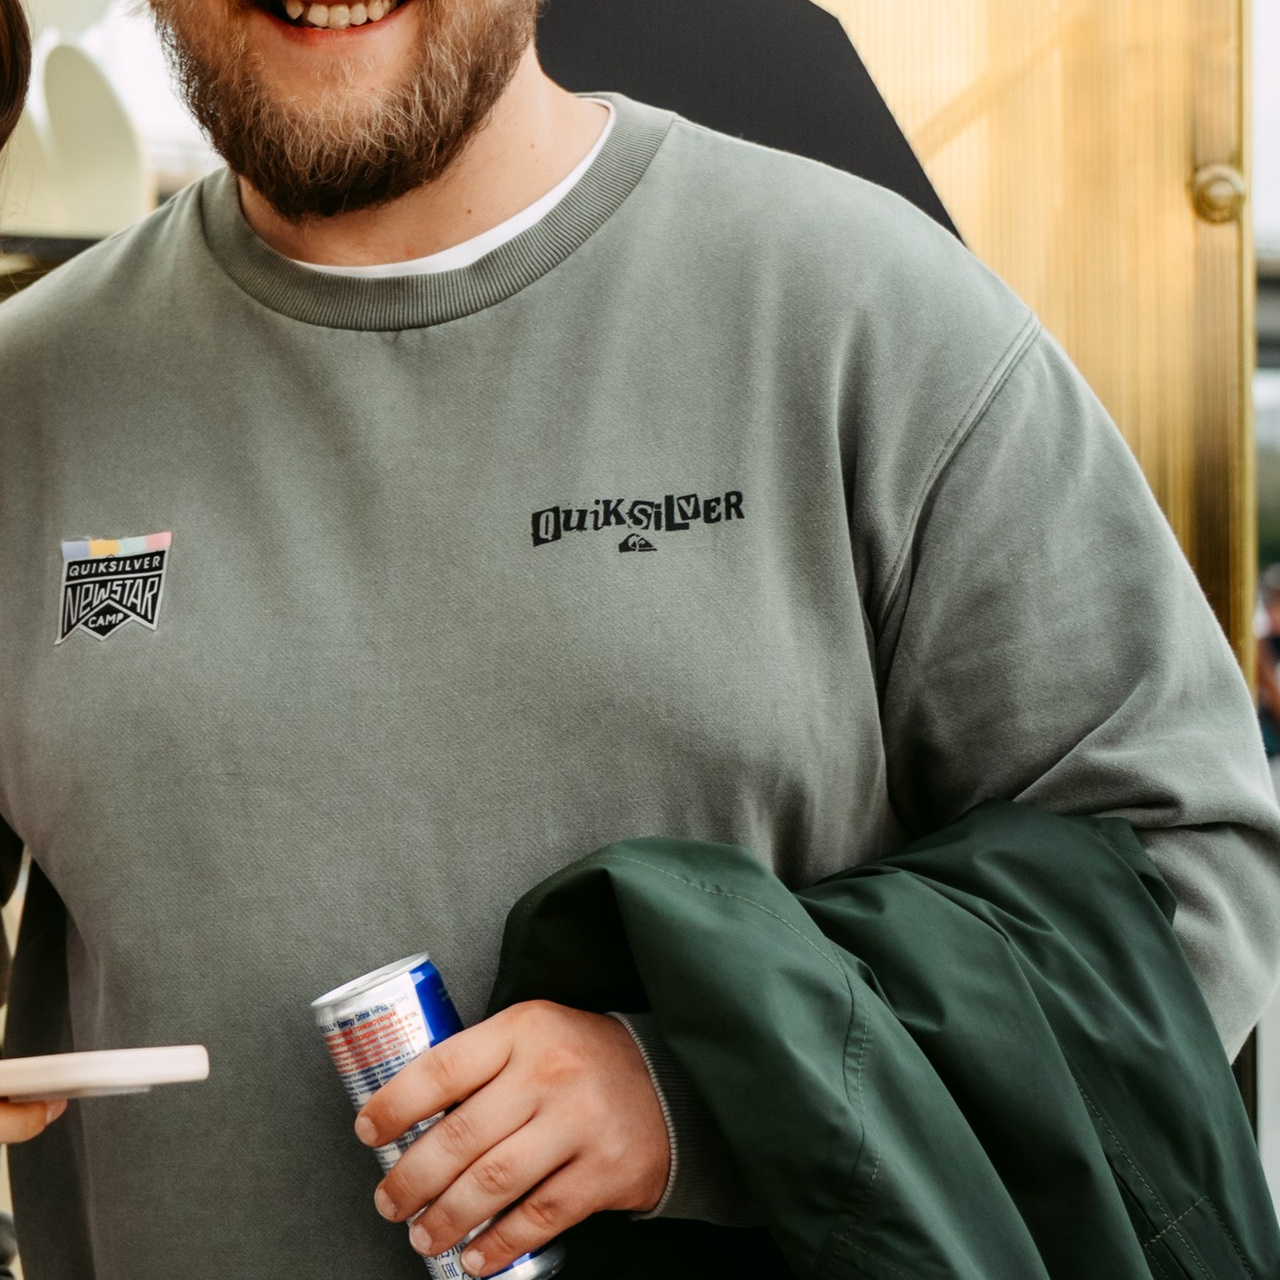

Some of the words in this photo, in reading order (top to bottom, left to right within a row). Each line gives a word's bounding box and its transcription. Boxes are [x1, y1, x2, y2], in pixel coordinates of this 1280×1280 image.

[69, 555, 161, 577] QUIKSILVER
[88, 612, 124, 628] CAMP
[355, 1009, 371, 1022] Drink
